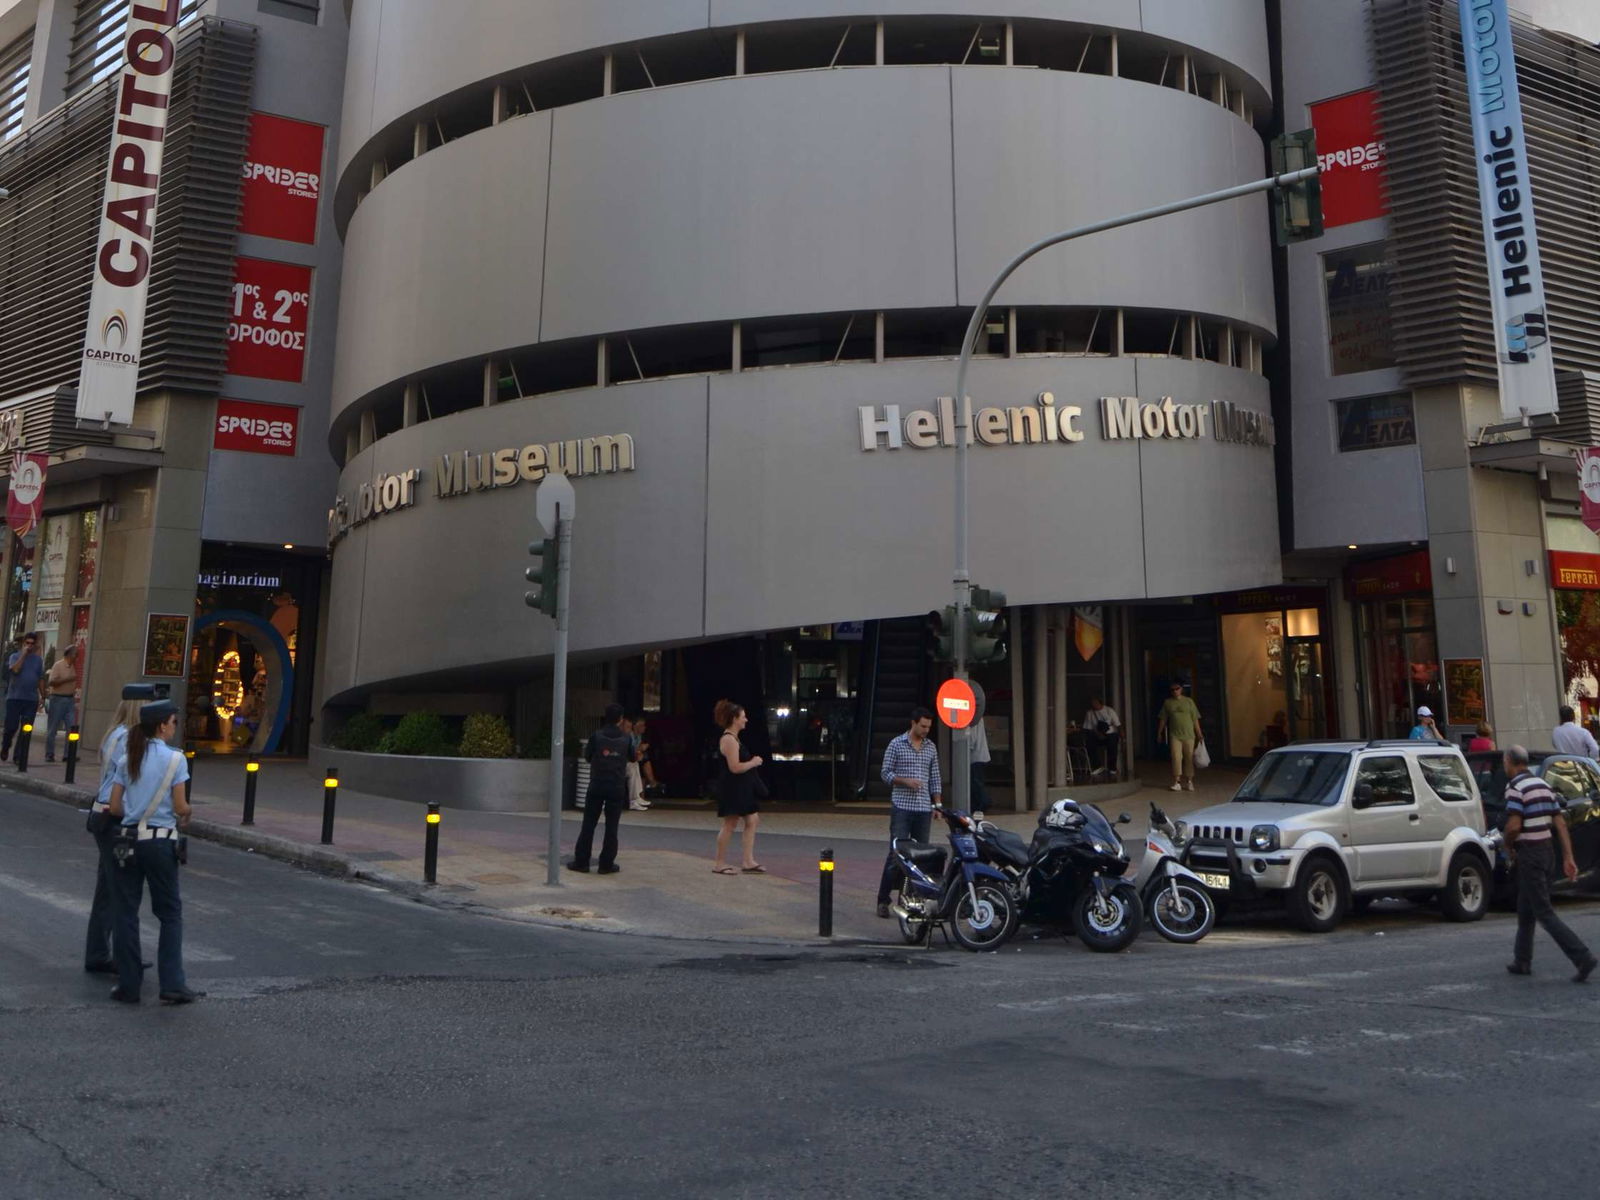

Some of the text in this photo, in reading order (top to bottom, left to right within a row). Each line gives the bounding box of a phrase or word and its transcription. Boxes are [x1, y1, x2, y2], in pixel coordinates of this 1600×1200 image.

[242, 161, 319, 191] SPRIDER
[287, 188, 318, 199] STORES
[1484, 125, 1533, 298] Hellenic
[253, 301, 267, 320] &
[86, 348, 138, 364] CAPITOL
[218, 415, 294, 439] SPRIDER
[857, 392, 1084, 451] Hellenic
[1099, 395, 1208, 441] Motor
[263, 438, 292, 447] STORES
[432, 432, 636, 499] Museum
[1560, 568, 1598, 585] Ferrari
